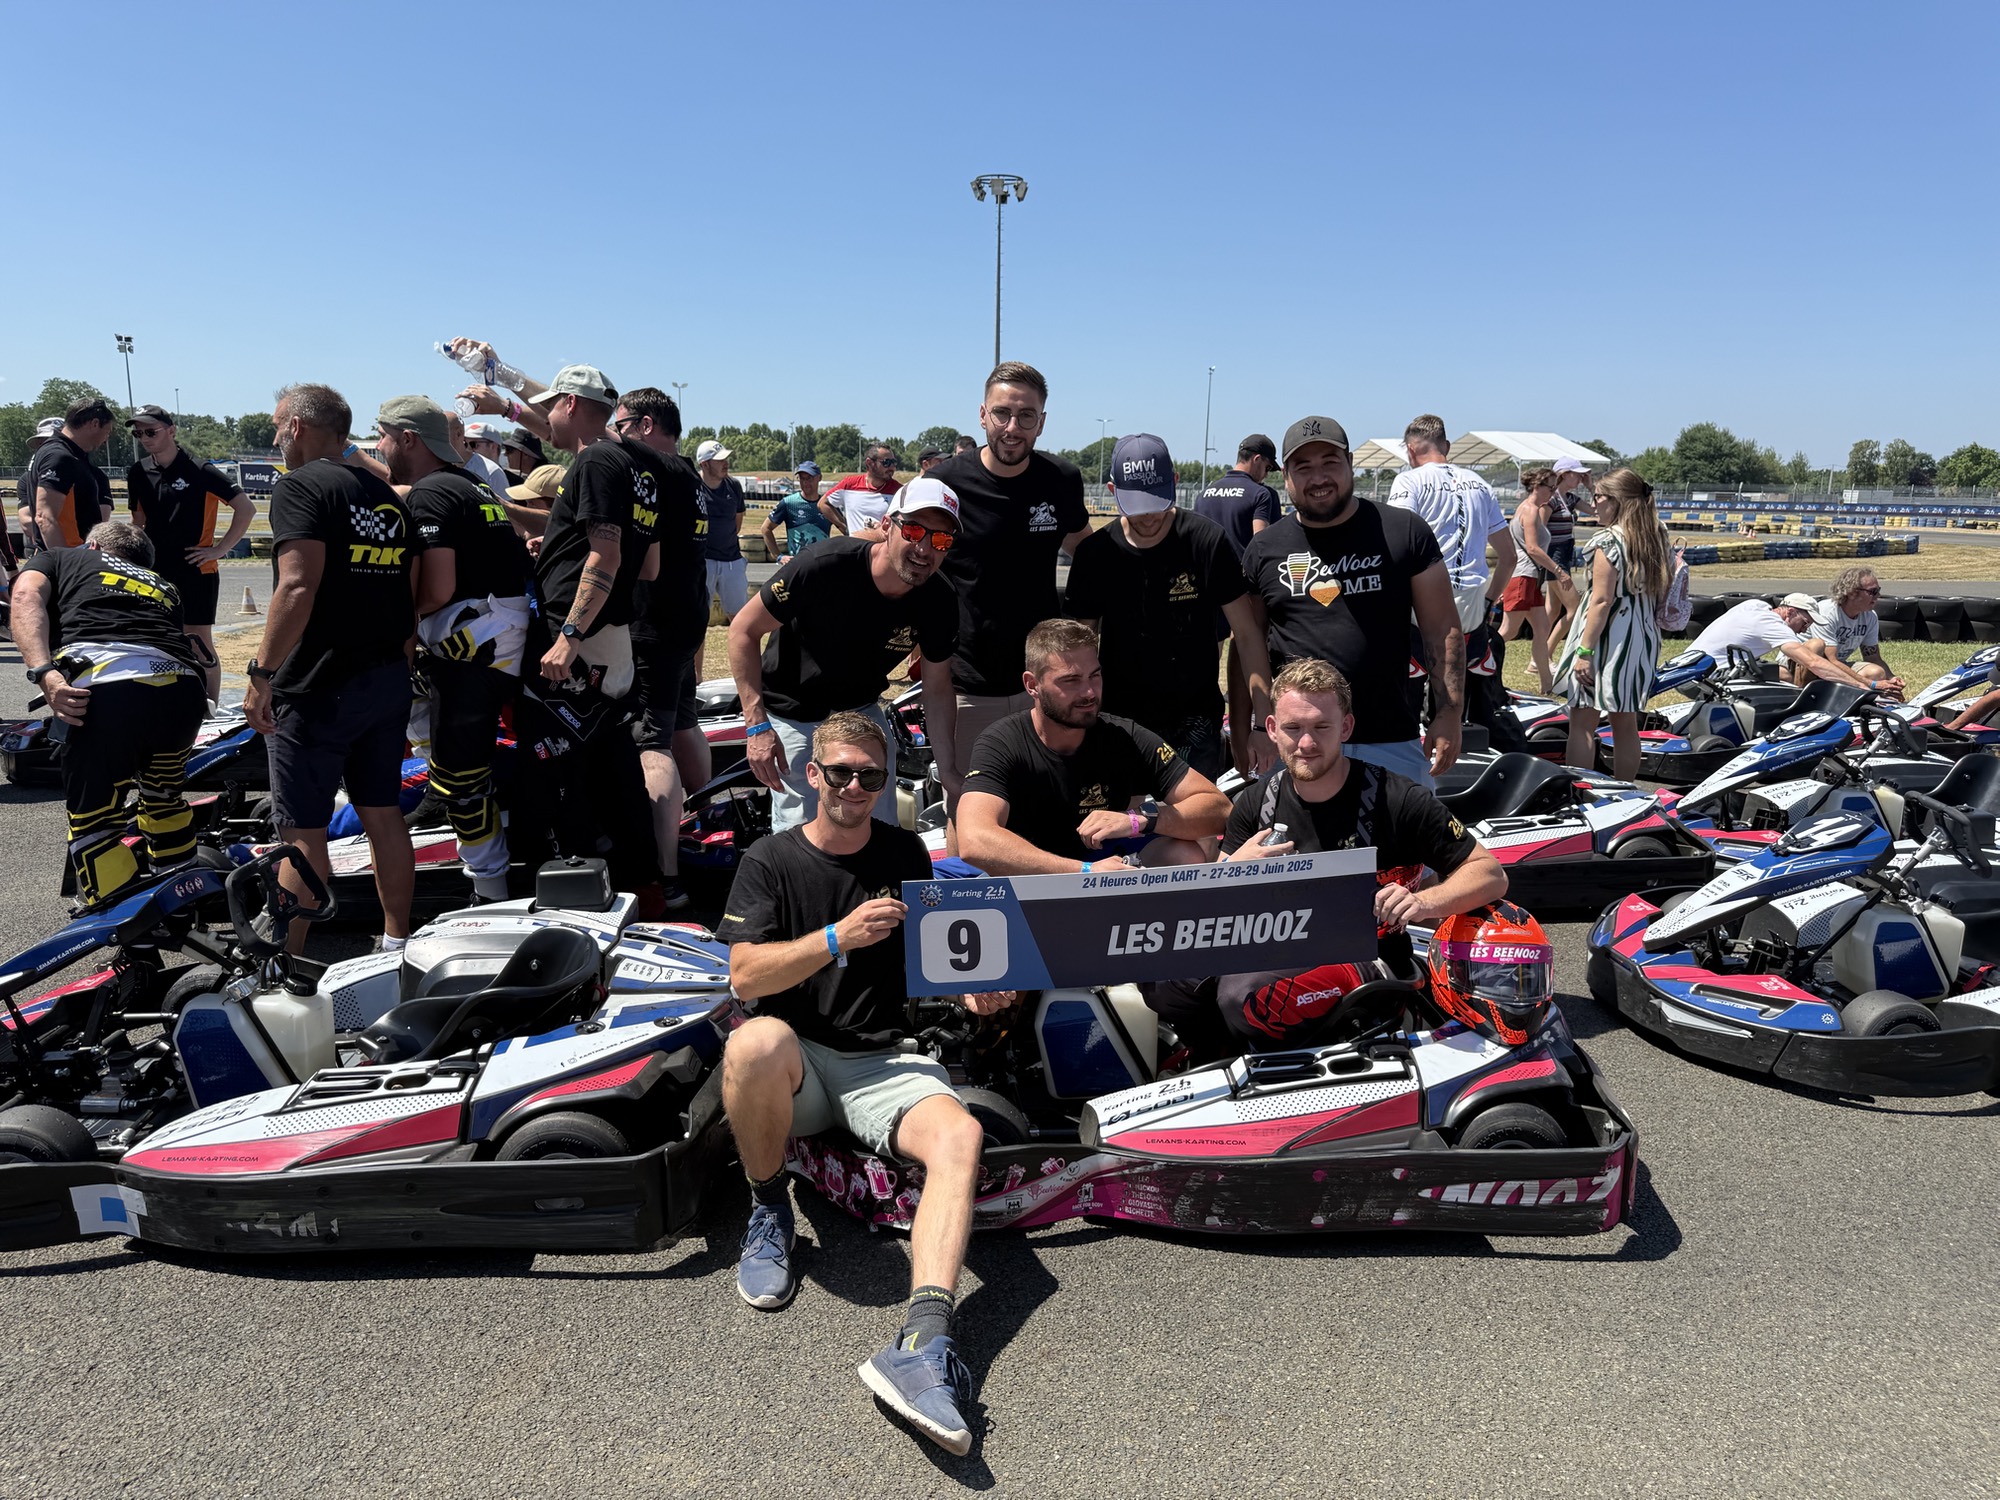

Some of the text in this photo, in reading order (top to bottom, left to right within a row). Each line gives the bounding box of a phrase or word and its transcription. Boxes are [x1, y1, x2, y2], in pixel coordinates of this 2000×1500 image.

[1123, 459, 1155, 474] BMW
[1124, 471, 1157, 481] PASSION
[245, 473, 270, 482] Karting
[1141, 476, 1164, 485] TOUR
[1203, 487, 1246, 498] FRANCE
[1389, 490, 1409, 501] 44
[349, 544, 406, 565] TRK
[98, 571, 175, 612] TRK
[1343, 574, 1383, 596] ME
[1794, 816, 1863, 848] 14
[1082, 877, 1097, 889] 24
[1100, 876, 1138, 888] Heures
[1141, 873, 1168, 886] Open
[1171, 869, 1200, 882] KART
[1209, 864, 1259, 880] 27-28-29
[1261, 862, 1284, 875] Juin
[1287, 859, 1314, 872] 2025
[1772, 869, 1853, 897] LEMANS-KARTING.COM
[951, 885, 1006, 898] Karting 24h
[1106, 908, 1313, 956] LES BEENOOZ
[36, 936, 96, 972] LEMANS-KARTING.COM
[947, 919, 981, 971] 9
[1469, 946, 1489, 958] LES
[1296, 986, 1342, 1007] ASTARS
[1104, 1079, 1192, 1113] Karting 24h
[1136, 1093, 1195, 1113] SODI
[1145, 1138, 1248, 1146] LEMANS-KARTING.COM
